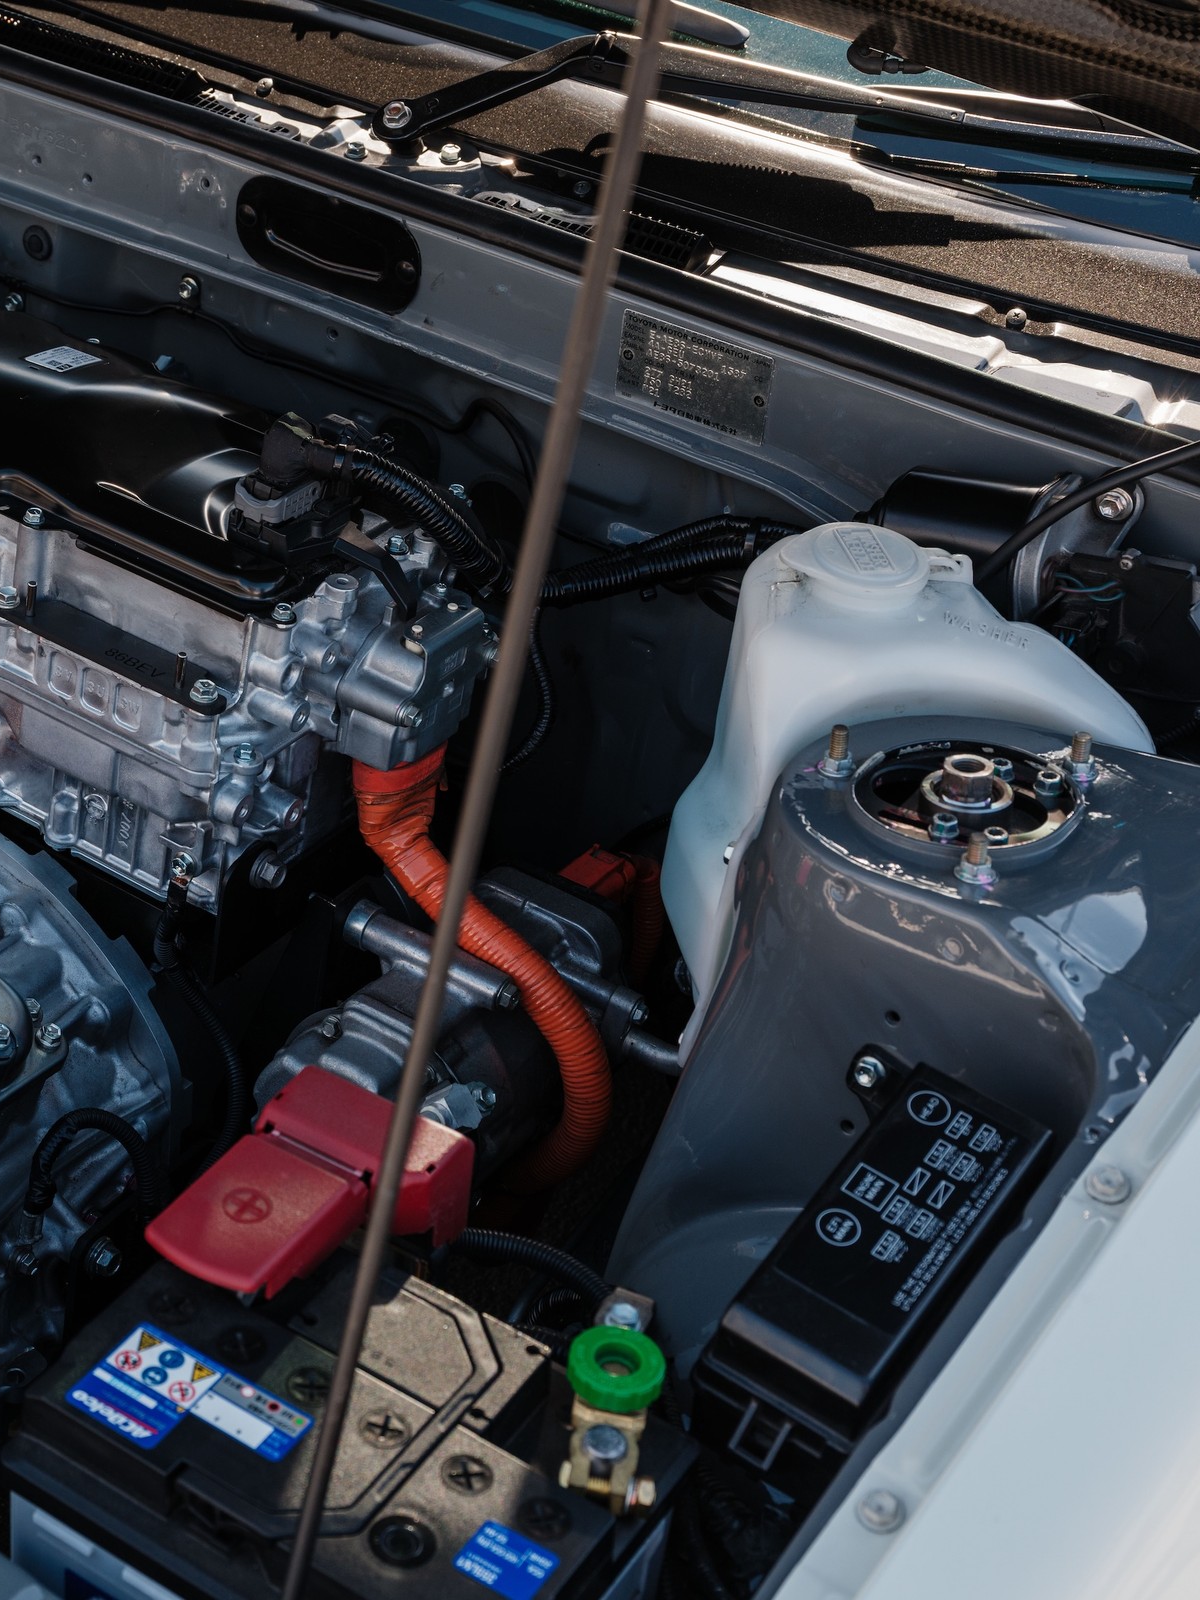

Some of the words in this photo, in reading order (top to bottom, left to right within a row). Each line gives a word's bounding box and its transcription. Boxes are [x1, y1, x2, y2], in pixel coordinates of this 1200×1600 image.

[623, 331, 645, 343] ENGINE
[628, 314, 657, 330] TOYOTA
[660, 325, 688, 340] MOTOR
[691, 336, 749, 361] CORPORATION
[653, 401, 737, 436] トヨタ自動車株式会社
[943, 609, 1031, 651] WASHER
[104, 647, 166, 678] 86BEV
[920, 1097, 940, 1120] HEAD
[833, 1219, 854, 1241] MAIN
[71, 1389, 154, 1440] ACDelco
